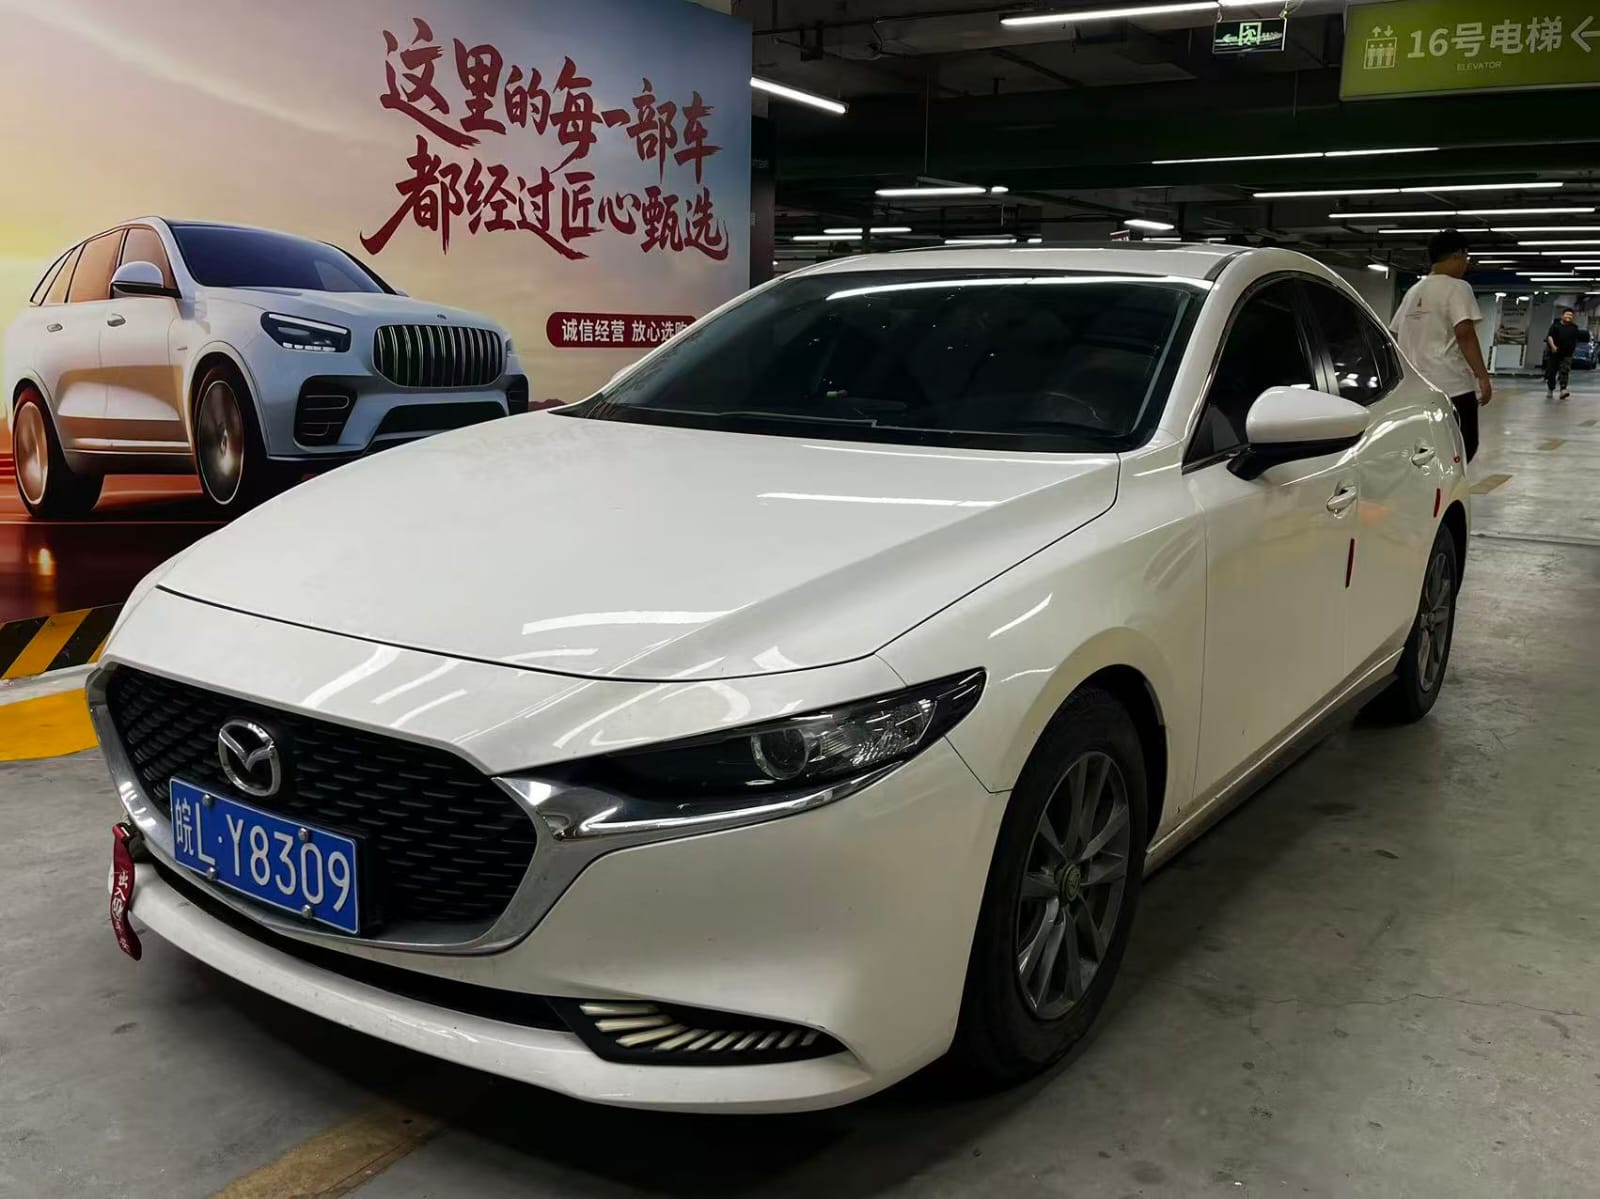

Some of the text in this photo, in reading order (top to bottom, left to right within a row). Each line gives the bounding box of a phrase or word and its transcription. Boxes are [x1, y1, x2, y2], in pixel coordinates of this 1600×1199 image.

[1407, 16, 1562, 59] 16号电梯
[1456, 61, 1502, 71] ELEVATOR
[380, 17, 723, 184] 这里的每一部车
[360, 134, 729, 260] 都经过匠心甄选
[562, 319, 625, 342] 诚信经营
